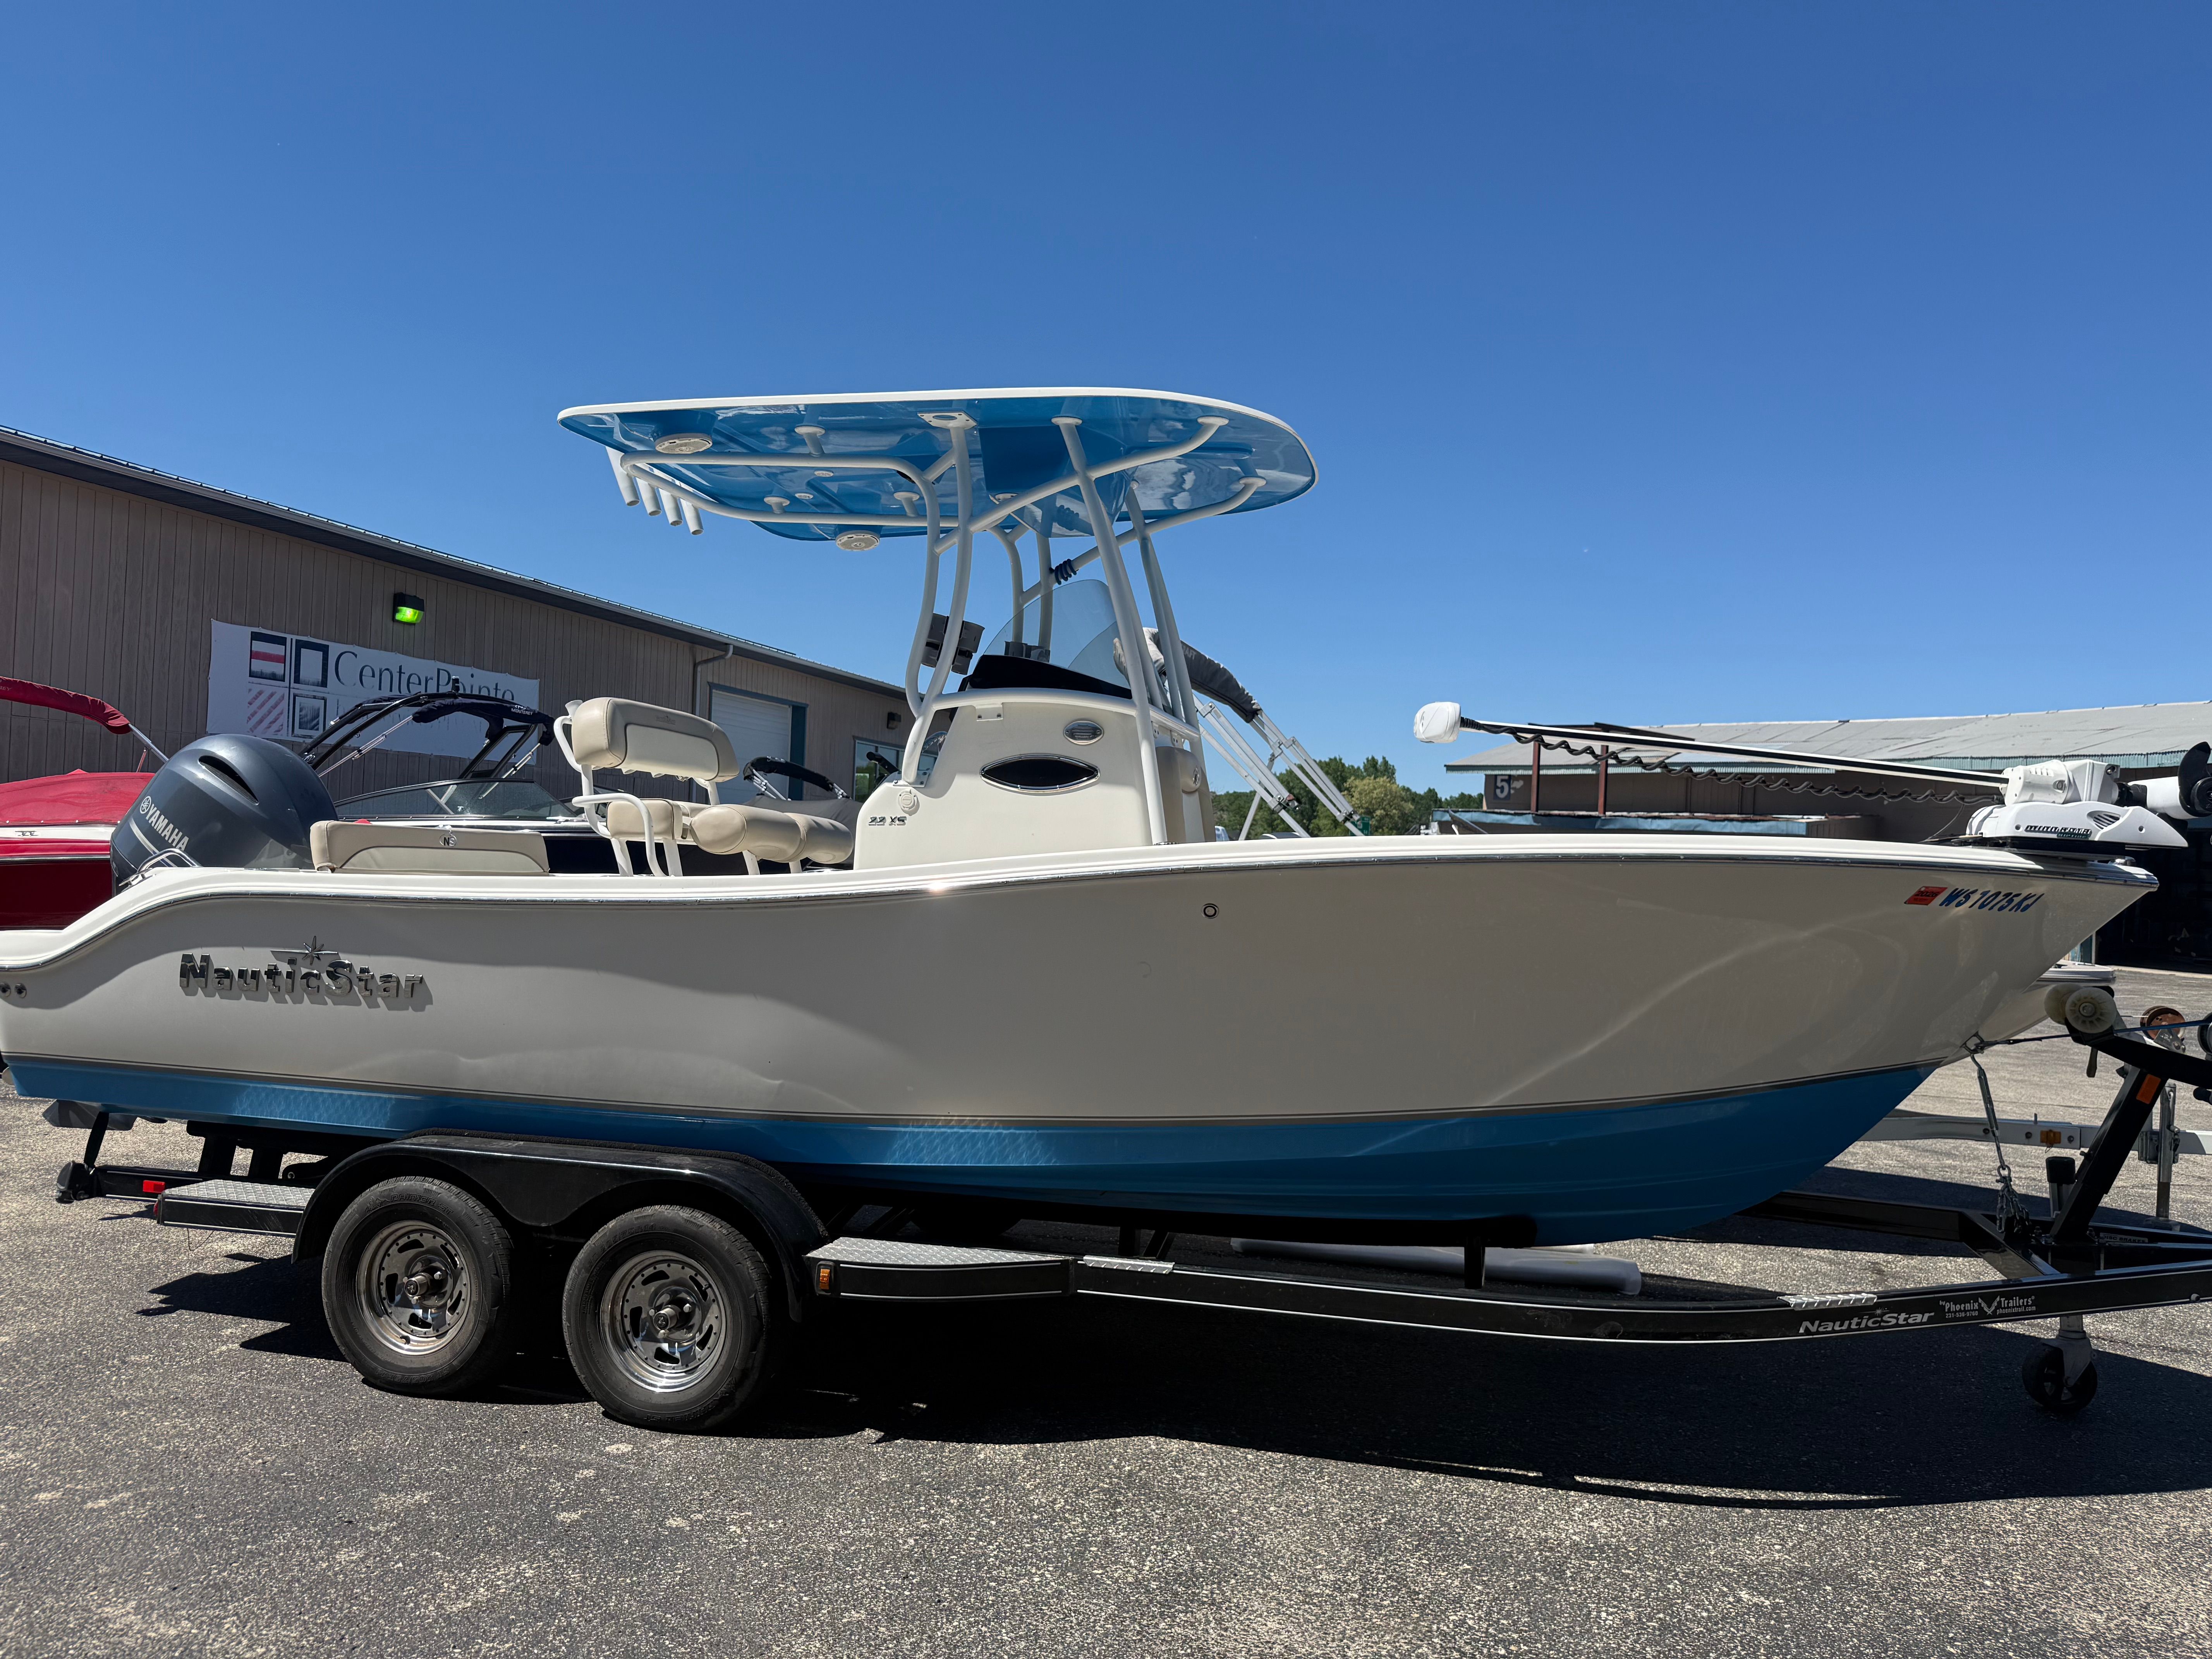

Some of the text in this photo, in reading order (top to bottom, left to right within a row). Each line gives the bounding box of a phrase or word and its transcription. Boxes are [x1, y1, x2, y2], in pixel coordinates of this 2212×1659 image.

[1496, 775, 1509, 799] 5
[146, 803, 190, 851] YAMAHA
[868, 816, 887, 824] 22
[179, 952, 423, 998] NauticStar
[438, 1203, 454, 1215] ST
[1945, 1300, 1979, 1312] Phoenix
[1996, 1306, 2036, 1316] phoenixtrail.com
[1799, 1311, 1935, 1333] NauticStar
